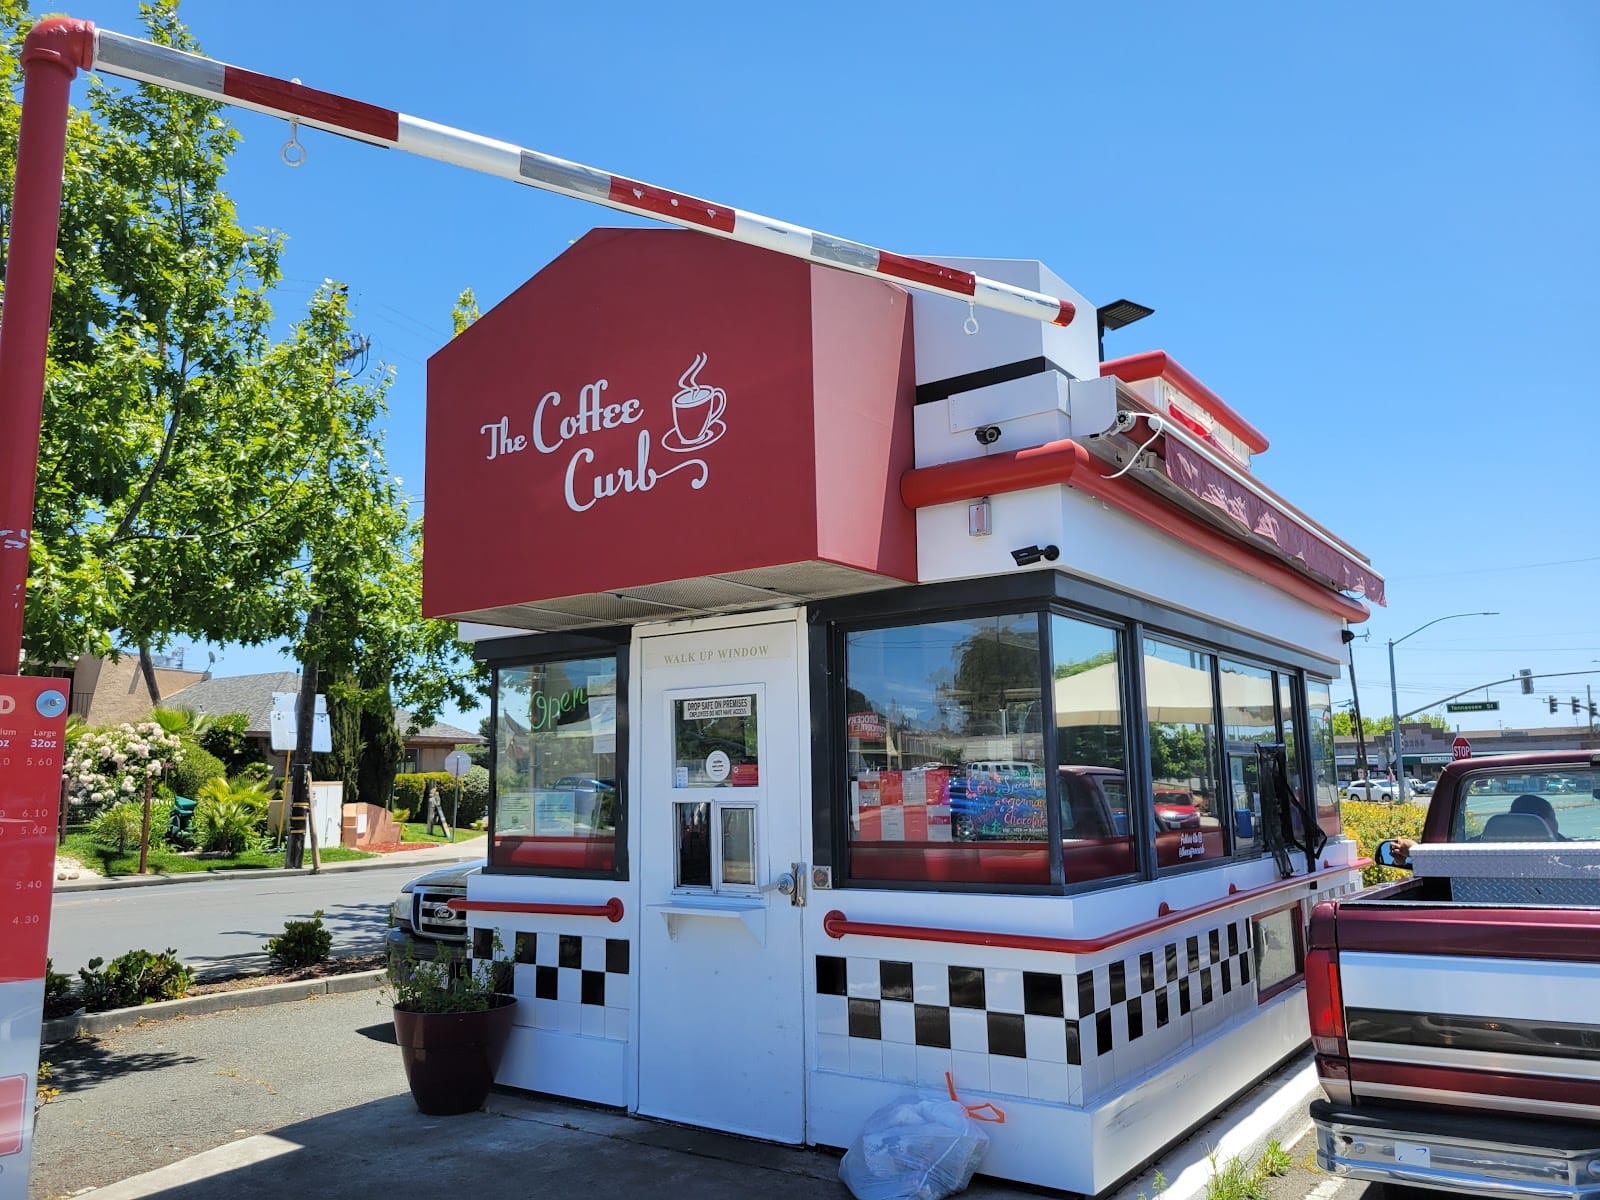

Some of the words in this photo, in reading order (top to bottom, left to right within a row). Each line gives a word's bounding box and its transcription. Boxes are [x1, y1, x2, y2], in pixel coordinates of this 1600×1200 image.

[480, 416, 527, 460] The
[533, 379, 644, 453] Coffee
[565, 430, 672, 511] Curb
[664, 652, 696, 664] WALK
[700, 651, 714, 661] UP
[718, 645, 769, 659] WINDOW
[529, 687, 588, 729] Open
[687, 702, 701, 711] DROP
[702, 701, 713, 710] SAFE
[715, 700, 722, 709] ON
[723, 698, 748, 708] PREMISES
[33, 729, 57, 738] Large
[30, 738, 57, 748] 32oz
[1453, 746, 1470, 757] STOP
[26, 757, 53, 766] 5.60
[22, 808, 48, 818] 6.10
[21, 825, 47, 835] 5.60
[16, 880, 42, 890] 5.40
[12, 914, 39, 925] 4.30
